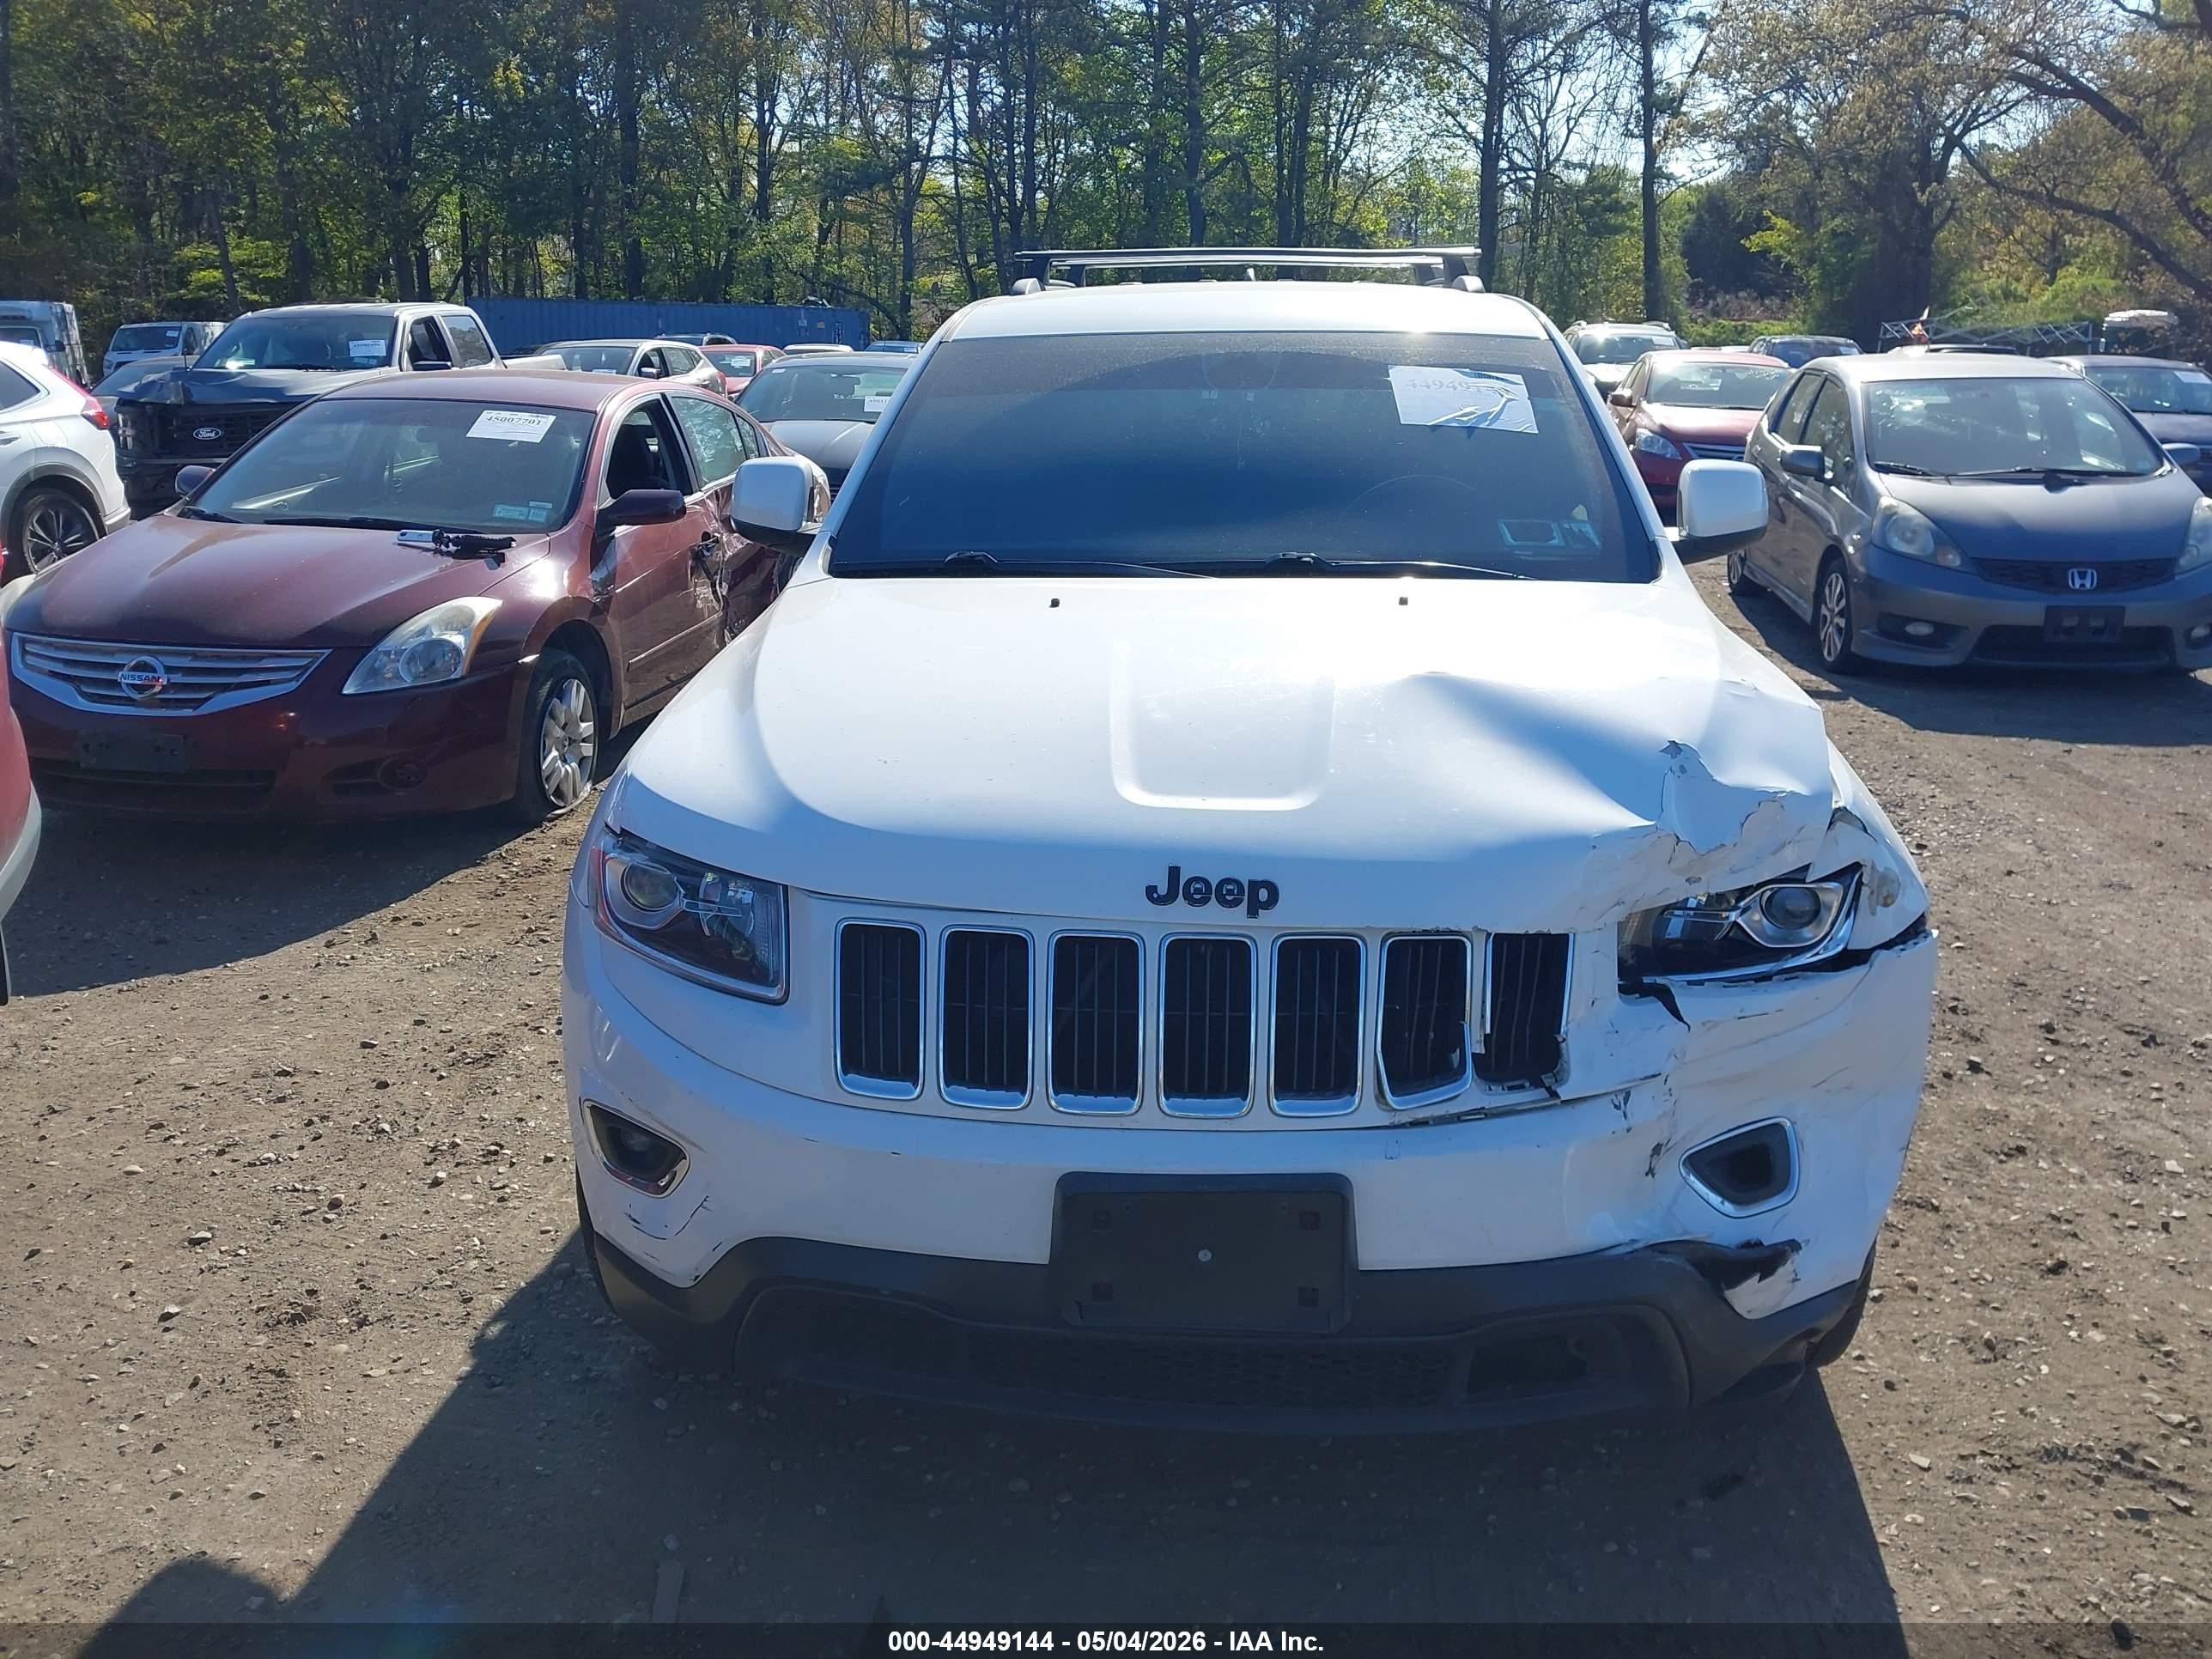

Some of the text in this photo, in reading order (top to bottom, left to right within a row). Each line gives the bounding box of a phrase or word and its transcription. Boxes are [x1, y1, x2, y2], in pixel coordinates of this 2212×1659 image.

[486, 416, 542, 426] 45007701
[197, 429, 218, 438] Ford
[121, 673, 161, 683] NISSAN
[1145, 865, 1279, 919] Jeep
